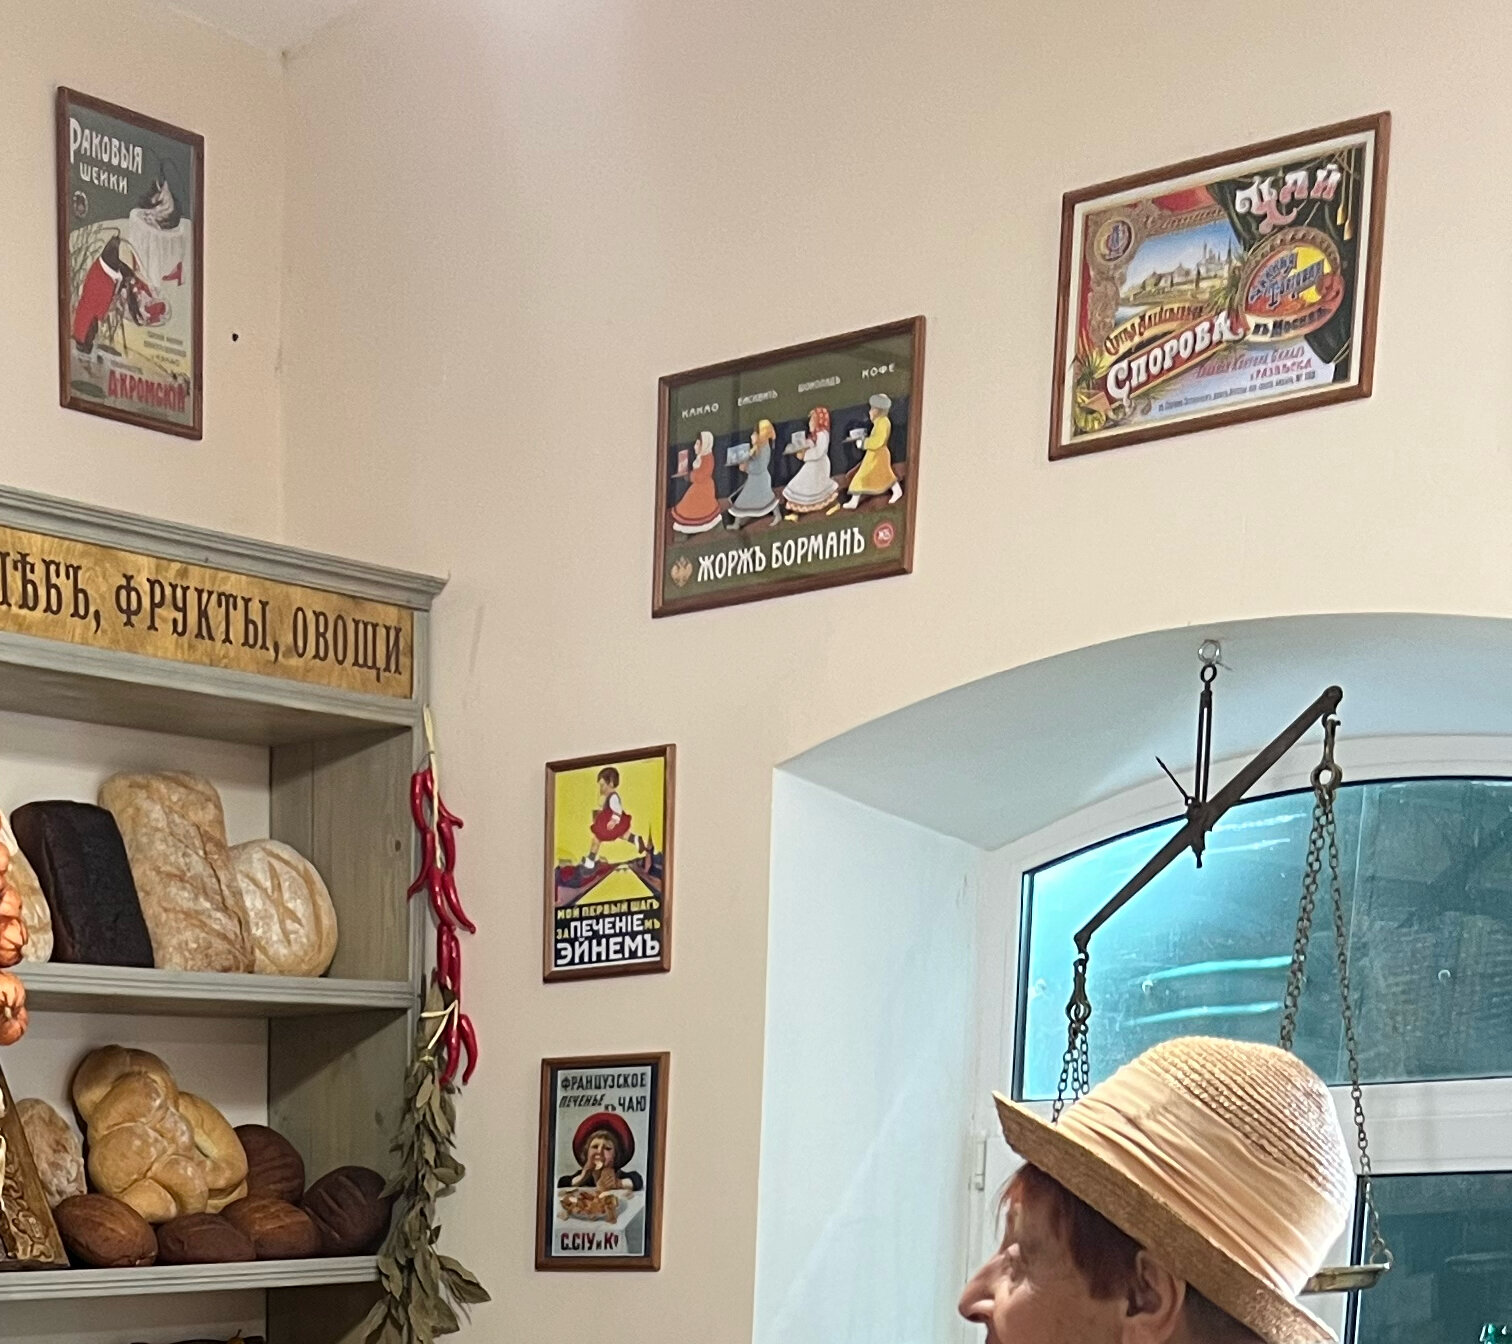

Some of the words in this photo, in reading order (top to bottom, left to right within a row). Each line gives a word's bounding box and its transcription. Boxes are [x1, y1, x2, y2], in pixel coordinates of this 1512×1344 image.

[69, 116, 143, 174] РАКОВЫЯ
[861, 363, 896, 379] КОФЕ
[681, 402, 719, 419] КАКАО
[697, 545, 766, 582] ЖОРЖЪ
[771, 527, 866, 569] БОРМАНЪ
[114, 572, 279, 664] ФРУКТЫ,
[291, 605, 403, 683] ОВОЩИ
[557, 906, 580, 920] МОЙ
[581, 901, 628, 917] ПЕРВЫЙ
[630, 898, 660, 912] ШАГЪ
[556, 932, 661, 966] ЭЙНЕМЪ
[560, 1072, 647, 1092] ФРАНЦУЗСКОЕ
[558, 1093, 606, 1109] ПЕЧЕНЬЕ
[618, 1095, 647, 1112] ЧАЮ
